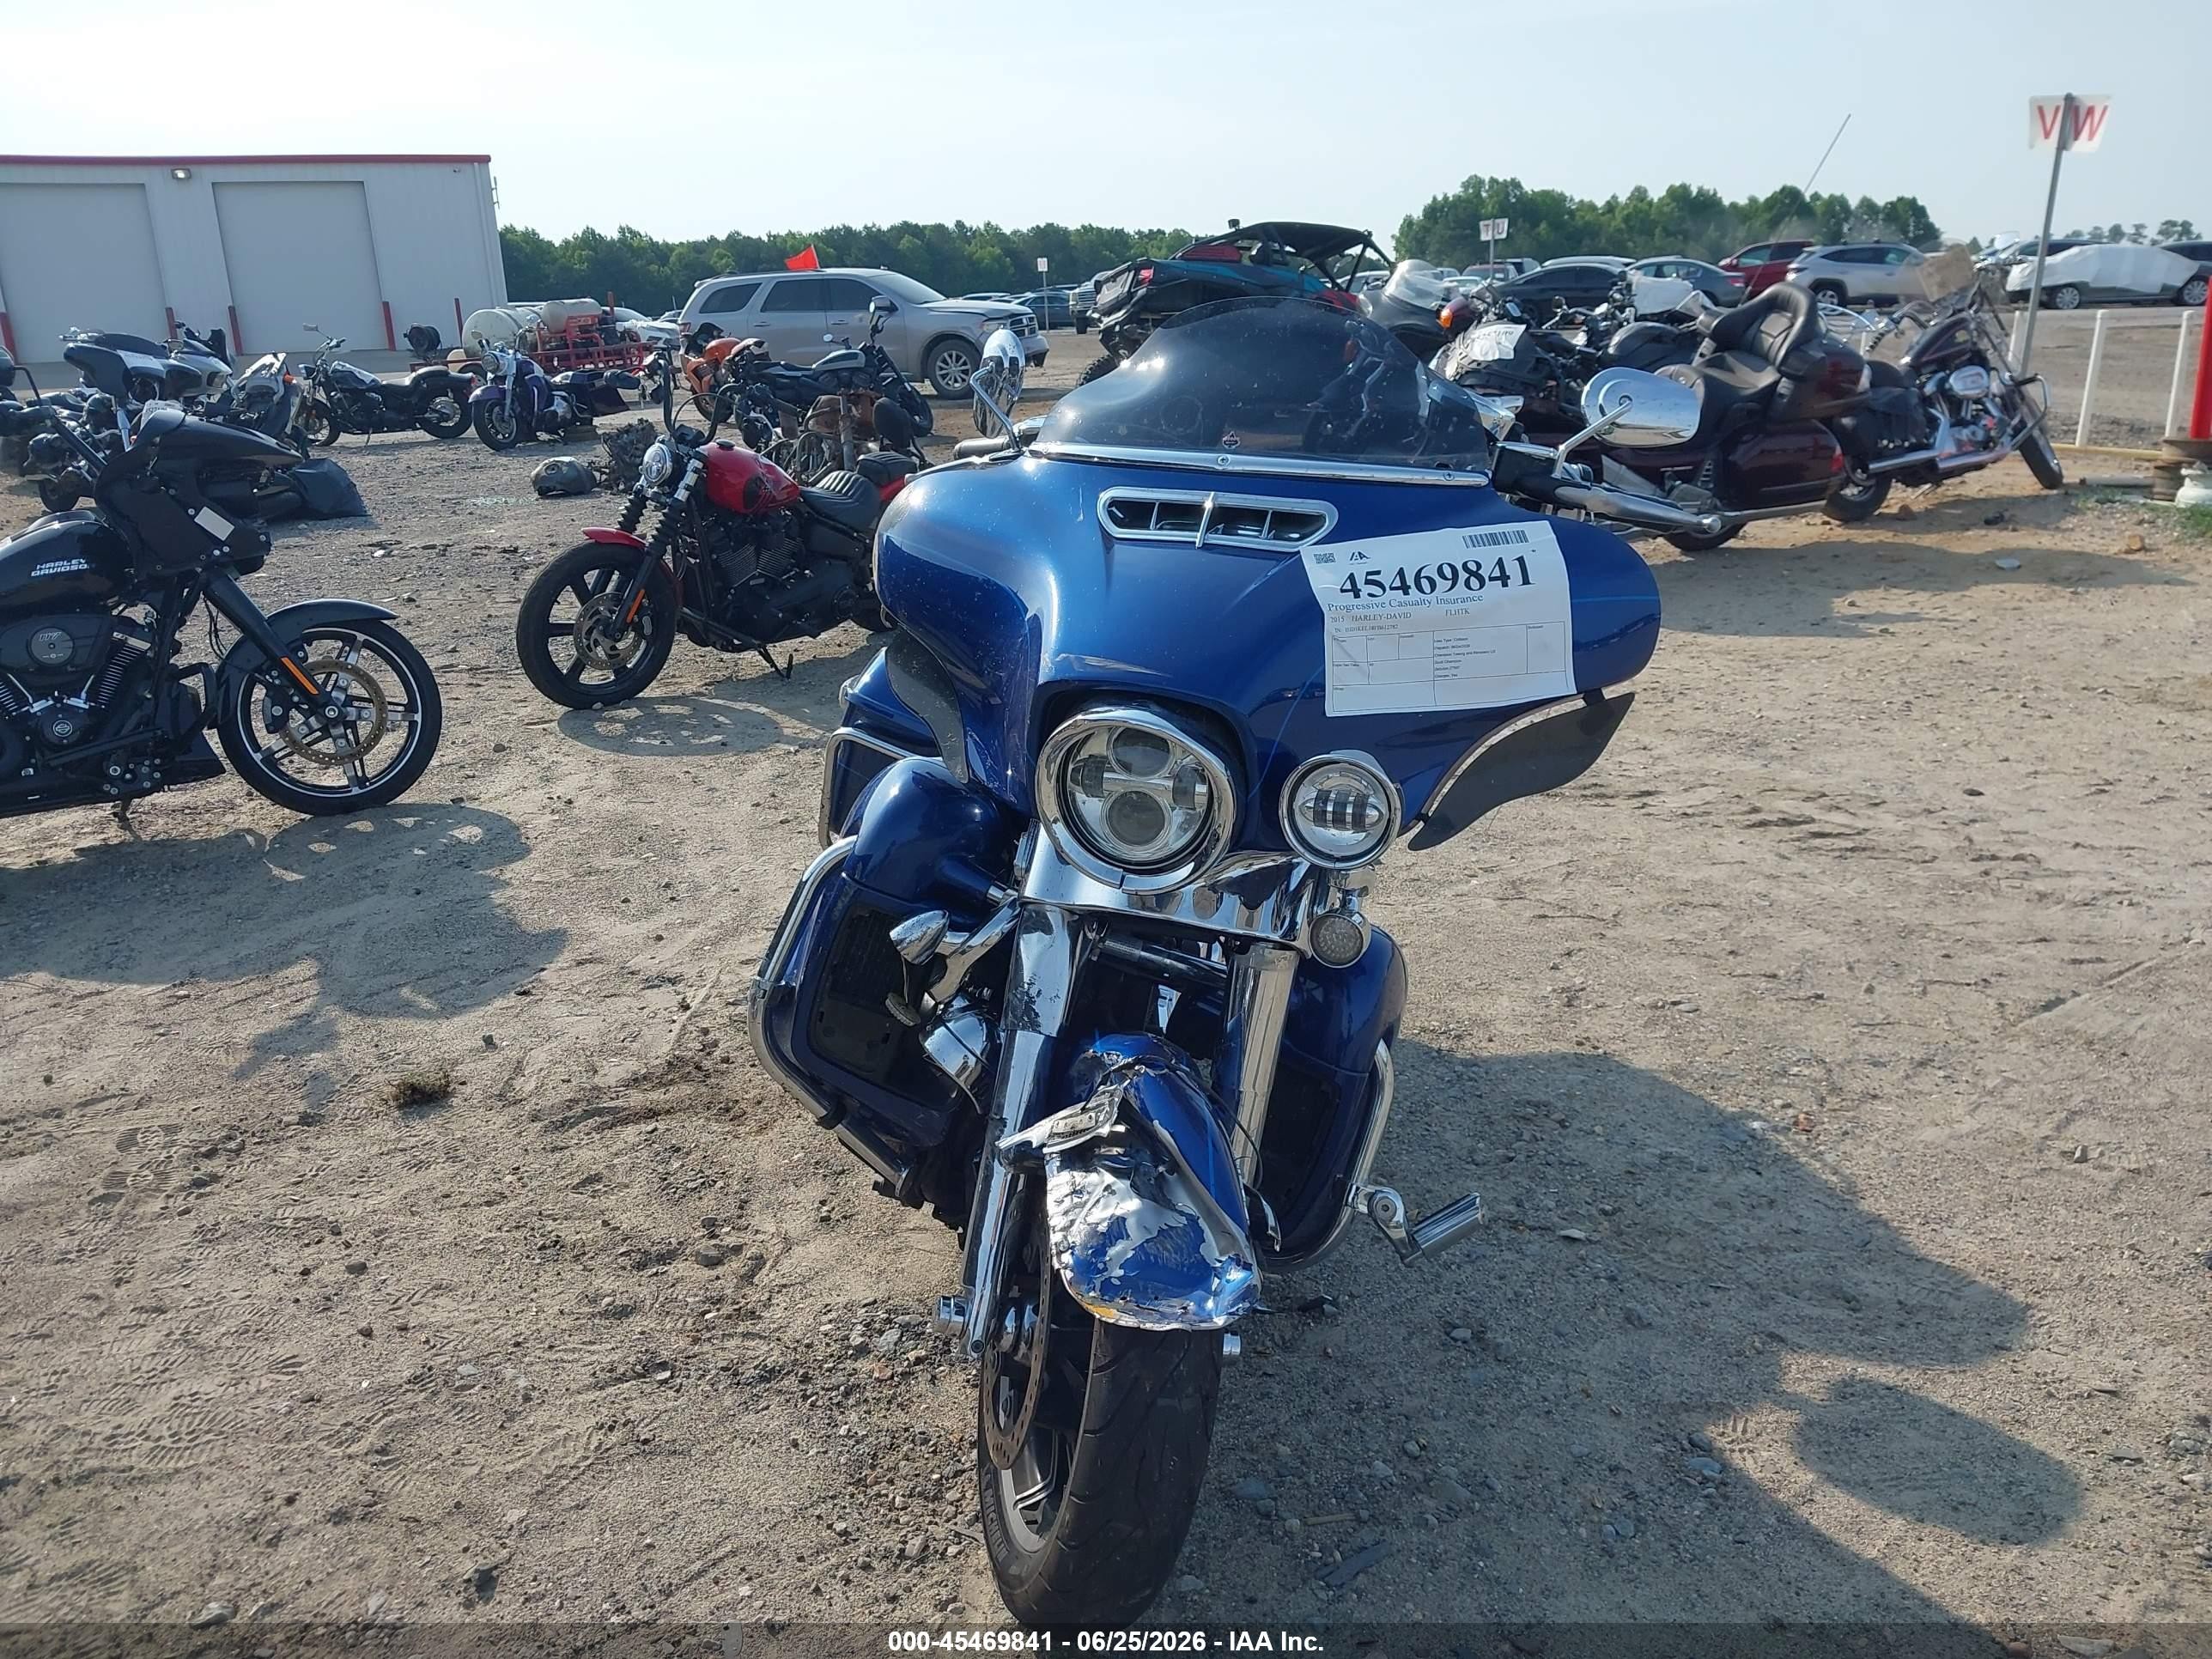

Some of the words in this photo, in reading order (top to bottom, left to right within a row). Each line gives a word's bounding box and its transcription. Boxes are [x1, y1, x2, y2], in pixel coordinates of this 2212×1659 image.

[2037, 104, 2061, 139] V
[2072, 104, 2109, 142] W
[1483, 223, 1492, 237] T
[36, 558, 87, 570] HARLEY
[1340, 555, 1535, 599] 45469841
[1328, 600, 1386, 612] Progressive
[1389, 597, 1431, 608] Casualty
[1436, 593, 1484, 605] Insurance
[1352, 611, 1412, 623] HARLEY-DAVID
